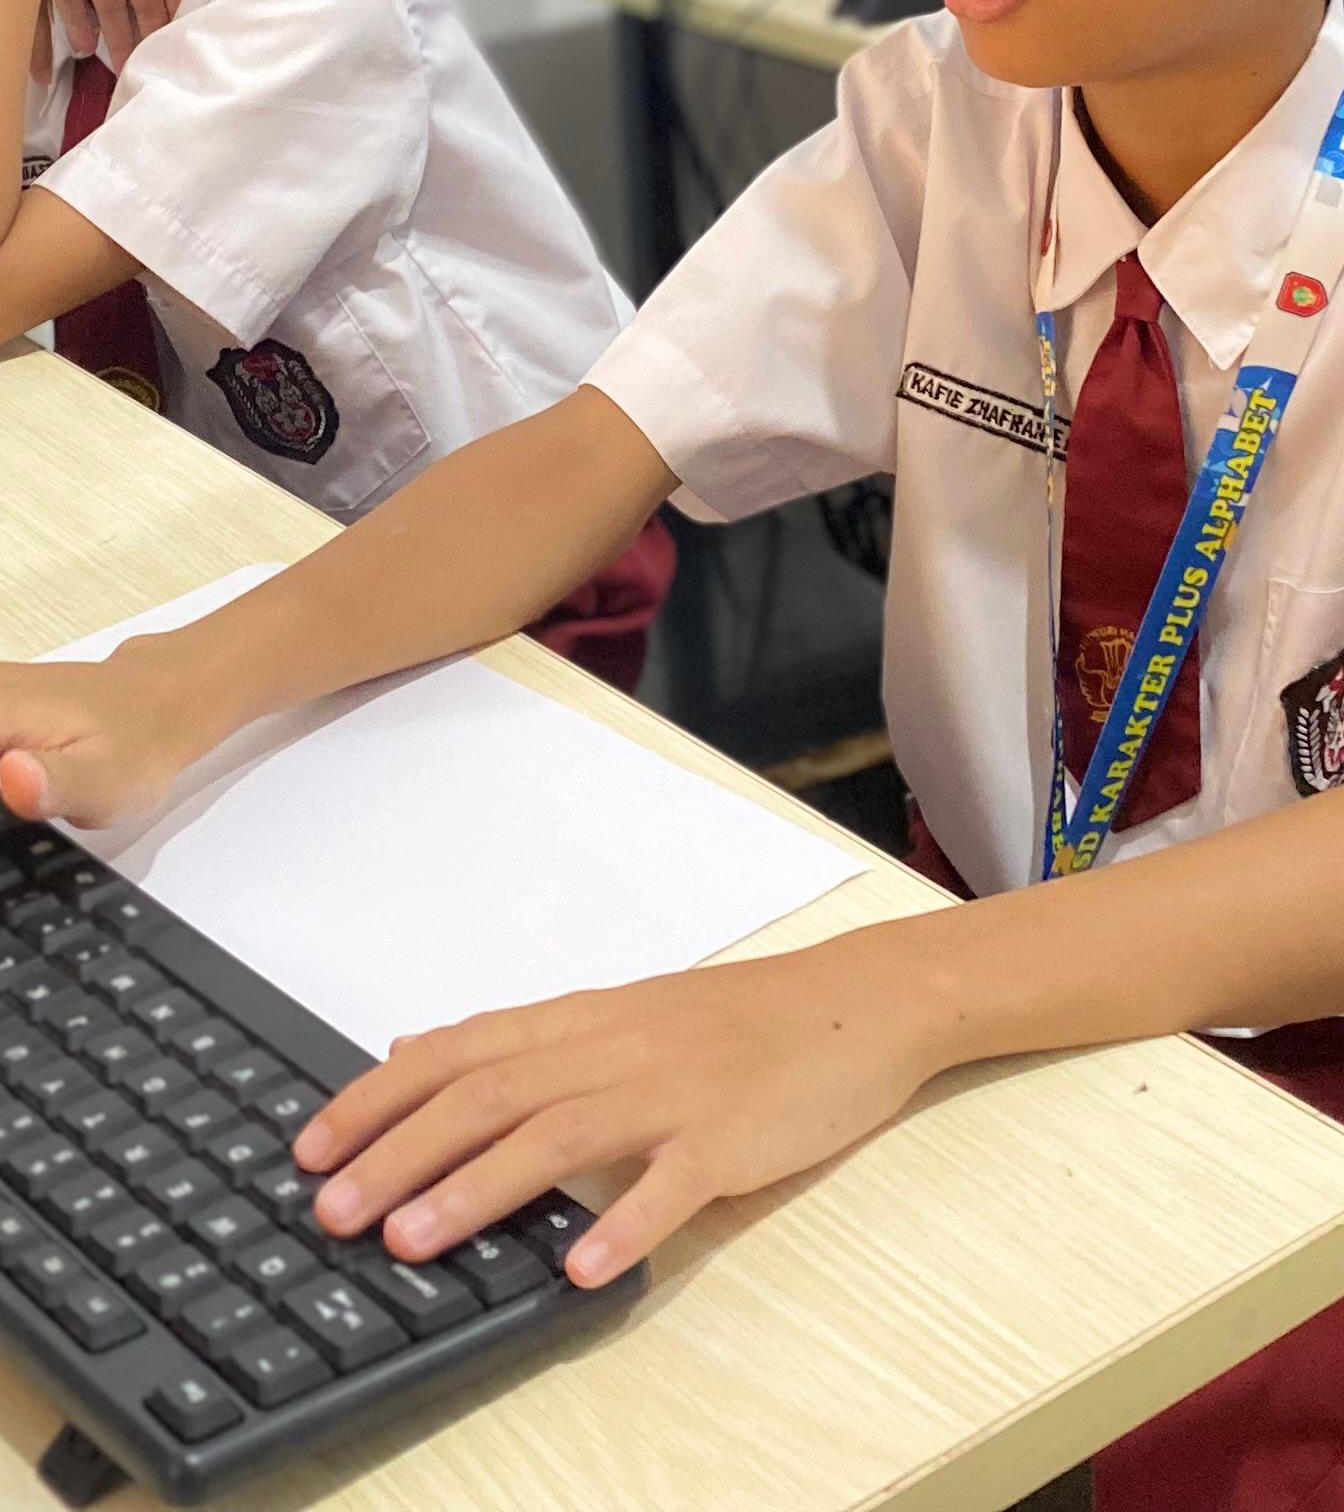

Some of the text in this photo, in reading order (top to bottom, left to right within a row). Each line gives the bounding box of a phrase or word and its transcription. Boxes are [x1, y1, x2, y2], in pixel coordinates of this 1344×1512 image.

[1071, 390, 1278, 870] SD KARAKTER PLUS ALPHABET
